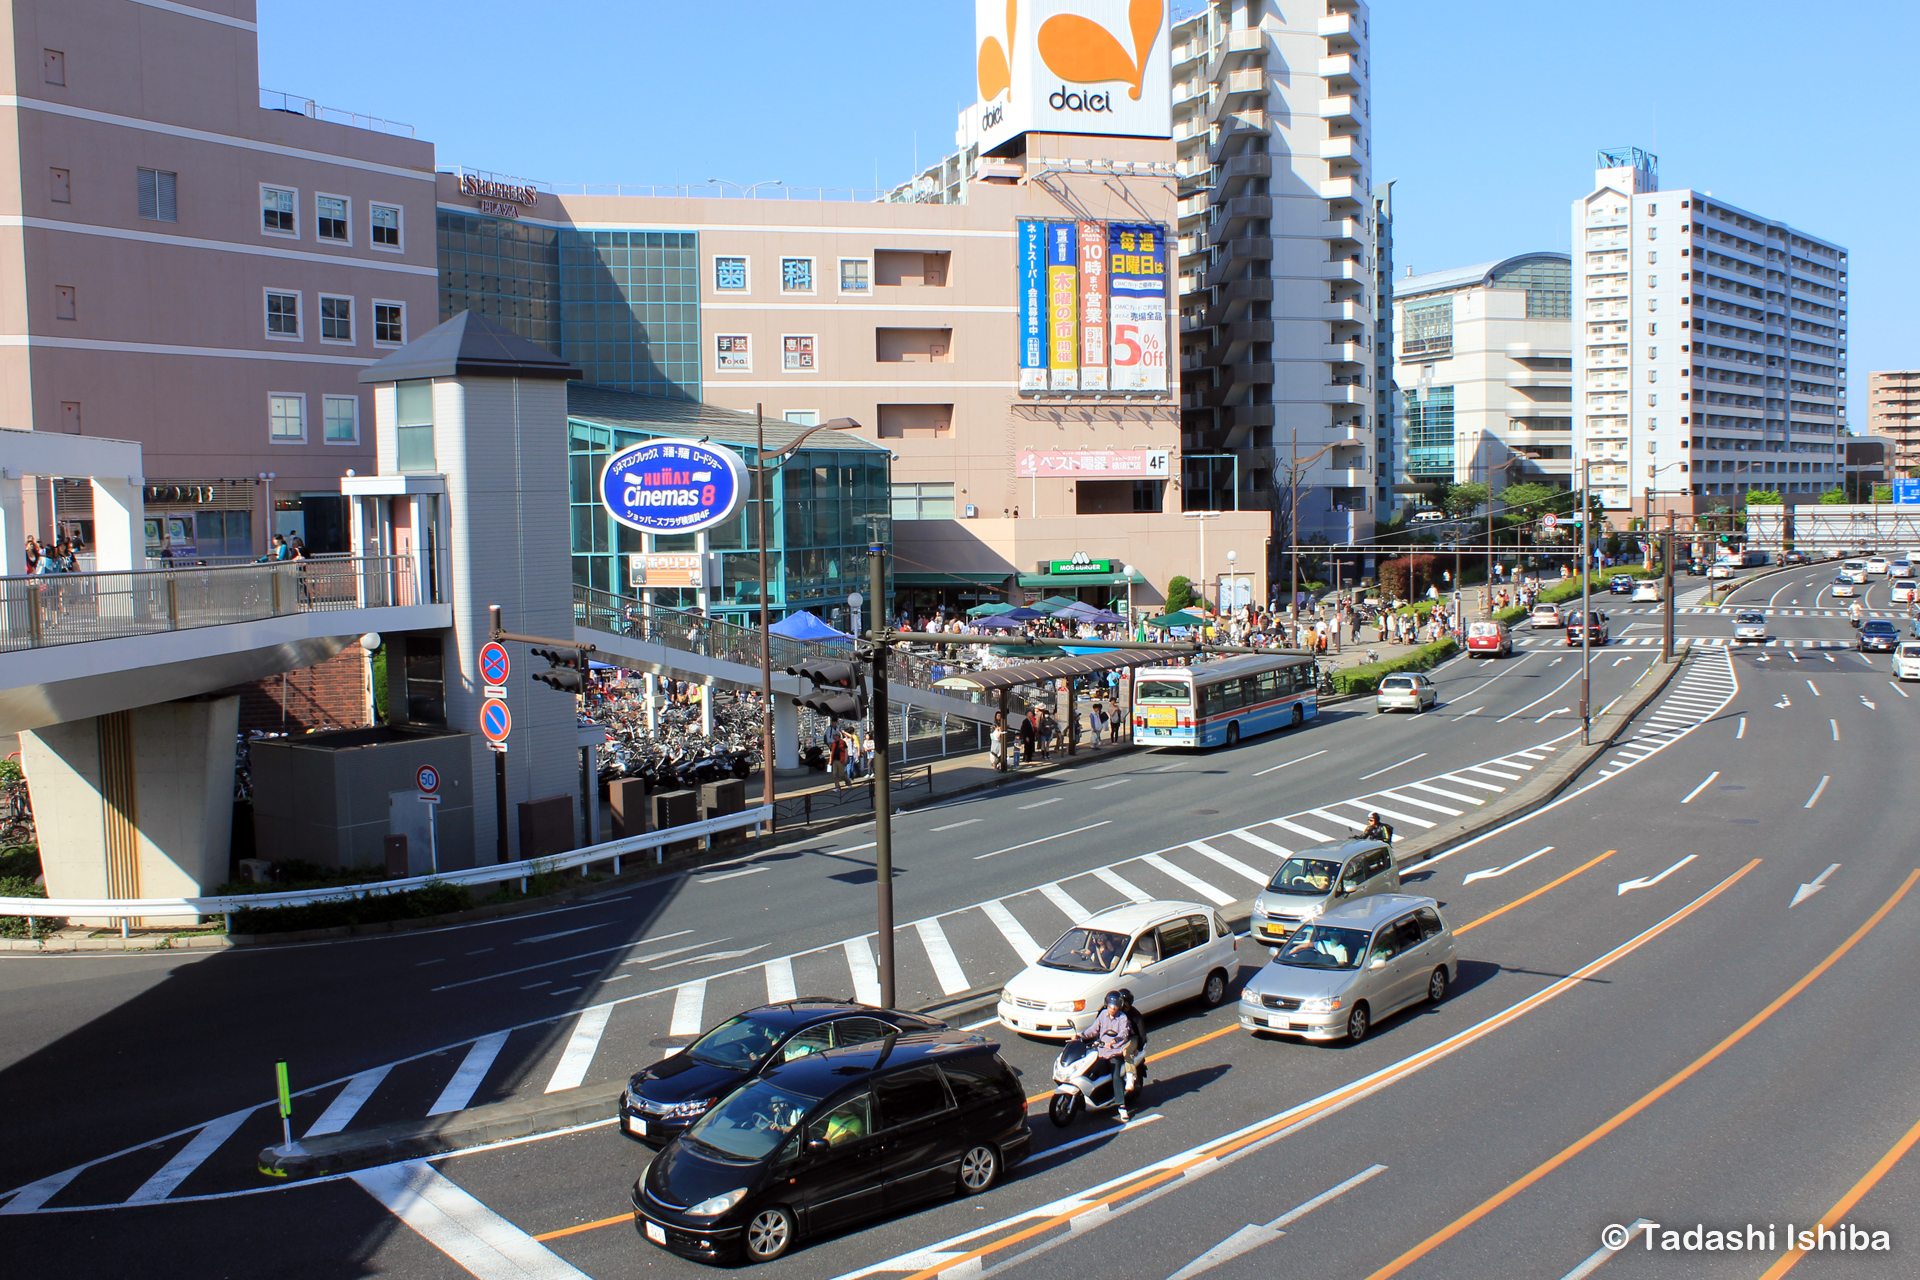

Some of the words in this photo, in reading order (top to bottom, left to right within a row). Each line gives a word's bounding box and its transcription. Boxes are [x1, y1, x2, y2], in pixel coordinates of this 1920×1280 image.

[1049, 85, 1113, 113] daiei
[982, 101, 1003, 131] daiei
[462, 174, 537, 207] SHOPPERS
[482, 200, 519, 218] PLAZA
[1120, 232, 1155, 252] 毎週
[1112, 254, 1164, 275] 日曜日は
[717, 261, 746, 288] 歯
[784, 261, 812, 289] 科
[1027, 224, 1039, 336] ネットスーパー会員募集中
[1054, 272, 1075, 338] 木曜の市
[1130, 311, 1163, 322] 売場全品
[719, 338, 748, 350] 手芸
[786, 338, 812, 350] 専門
[1057, 341, 1072, 362] 開催
[1114, 324, 1142, 366] 5
[719, 355, 748, 365] Tokai
[800, 354, 813, 366] 店
[1142, 350, 1164, 367] Off
[612, 448, 659, 476] シネマコンプレックス
[693, 451, 723, 470] ロードショー
[1040, 456, 1107, 471] ベスト電器
[1150, 456, 1166, 469] 4F
[623, 485, 700, 507] Cinemas
[701, 484, 716, 506] 8
[647, 555, 700, 570] ボウリング
[420, 772, 435, 786] 50
